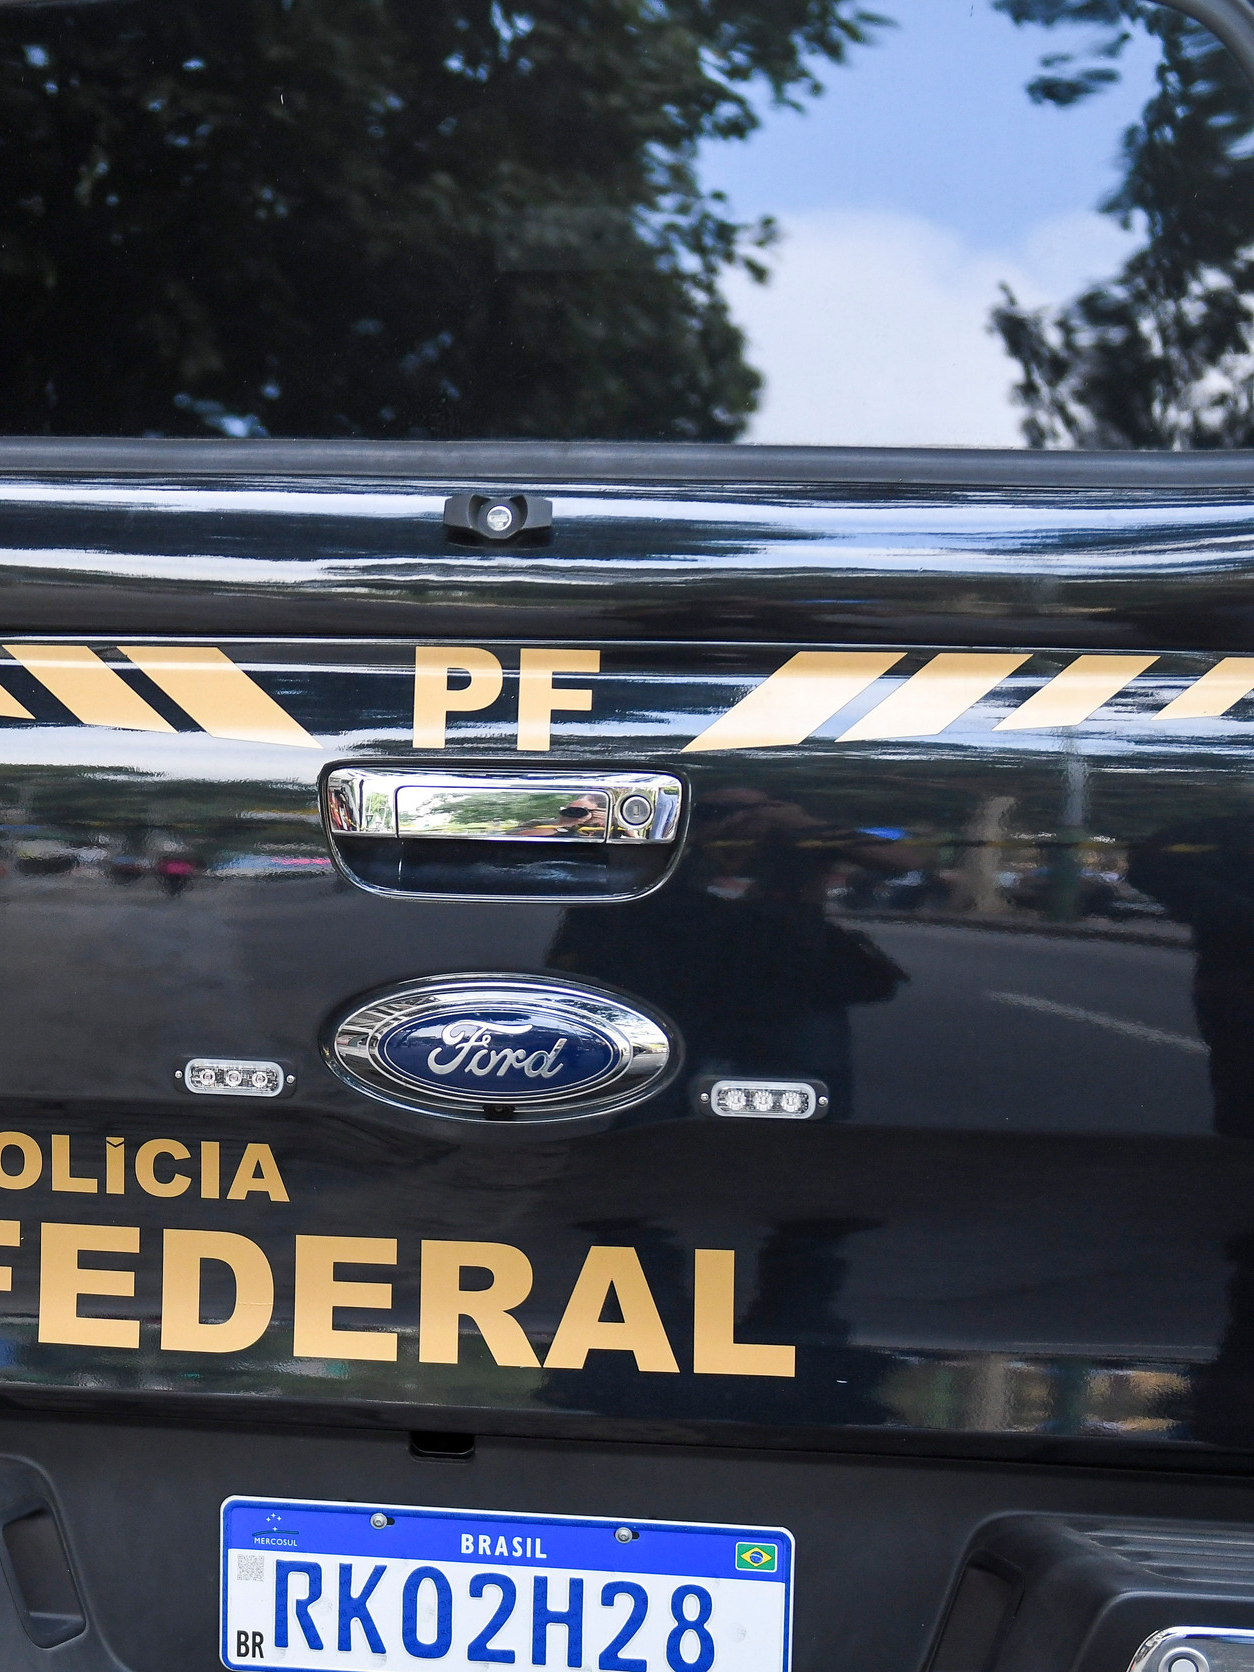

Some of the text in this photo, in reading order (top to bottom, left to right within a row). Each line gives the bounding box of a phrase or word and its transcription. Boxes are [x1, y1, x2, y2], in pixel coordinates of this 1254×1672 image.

[413, 645, 601, 752] PF
[427, 1019, 565, 1078] Ford
[254, 1537, 298, 1547] MERCOSUL
[460, 1532, 547, 1560] BRASIL
[236, 1630, 264, 1659] BR
